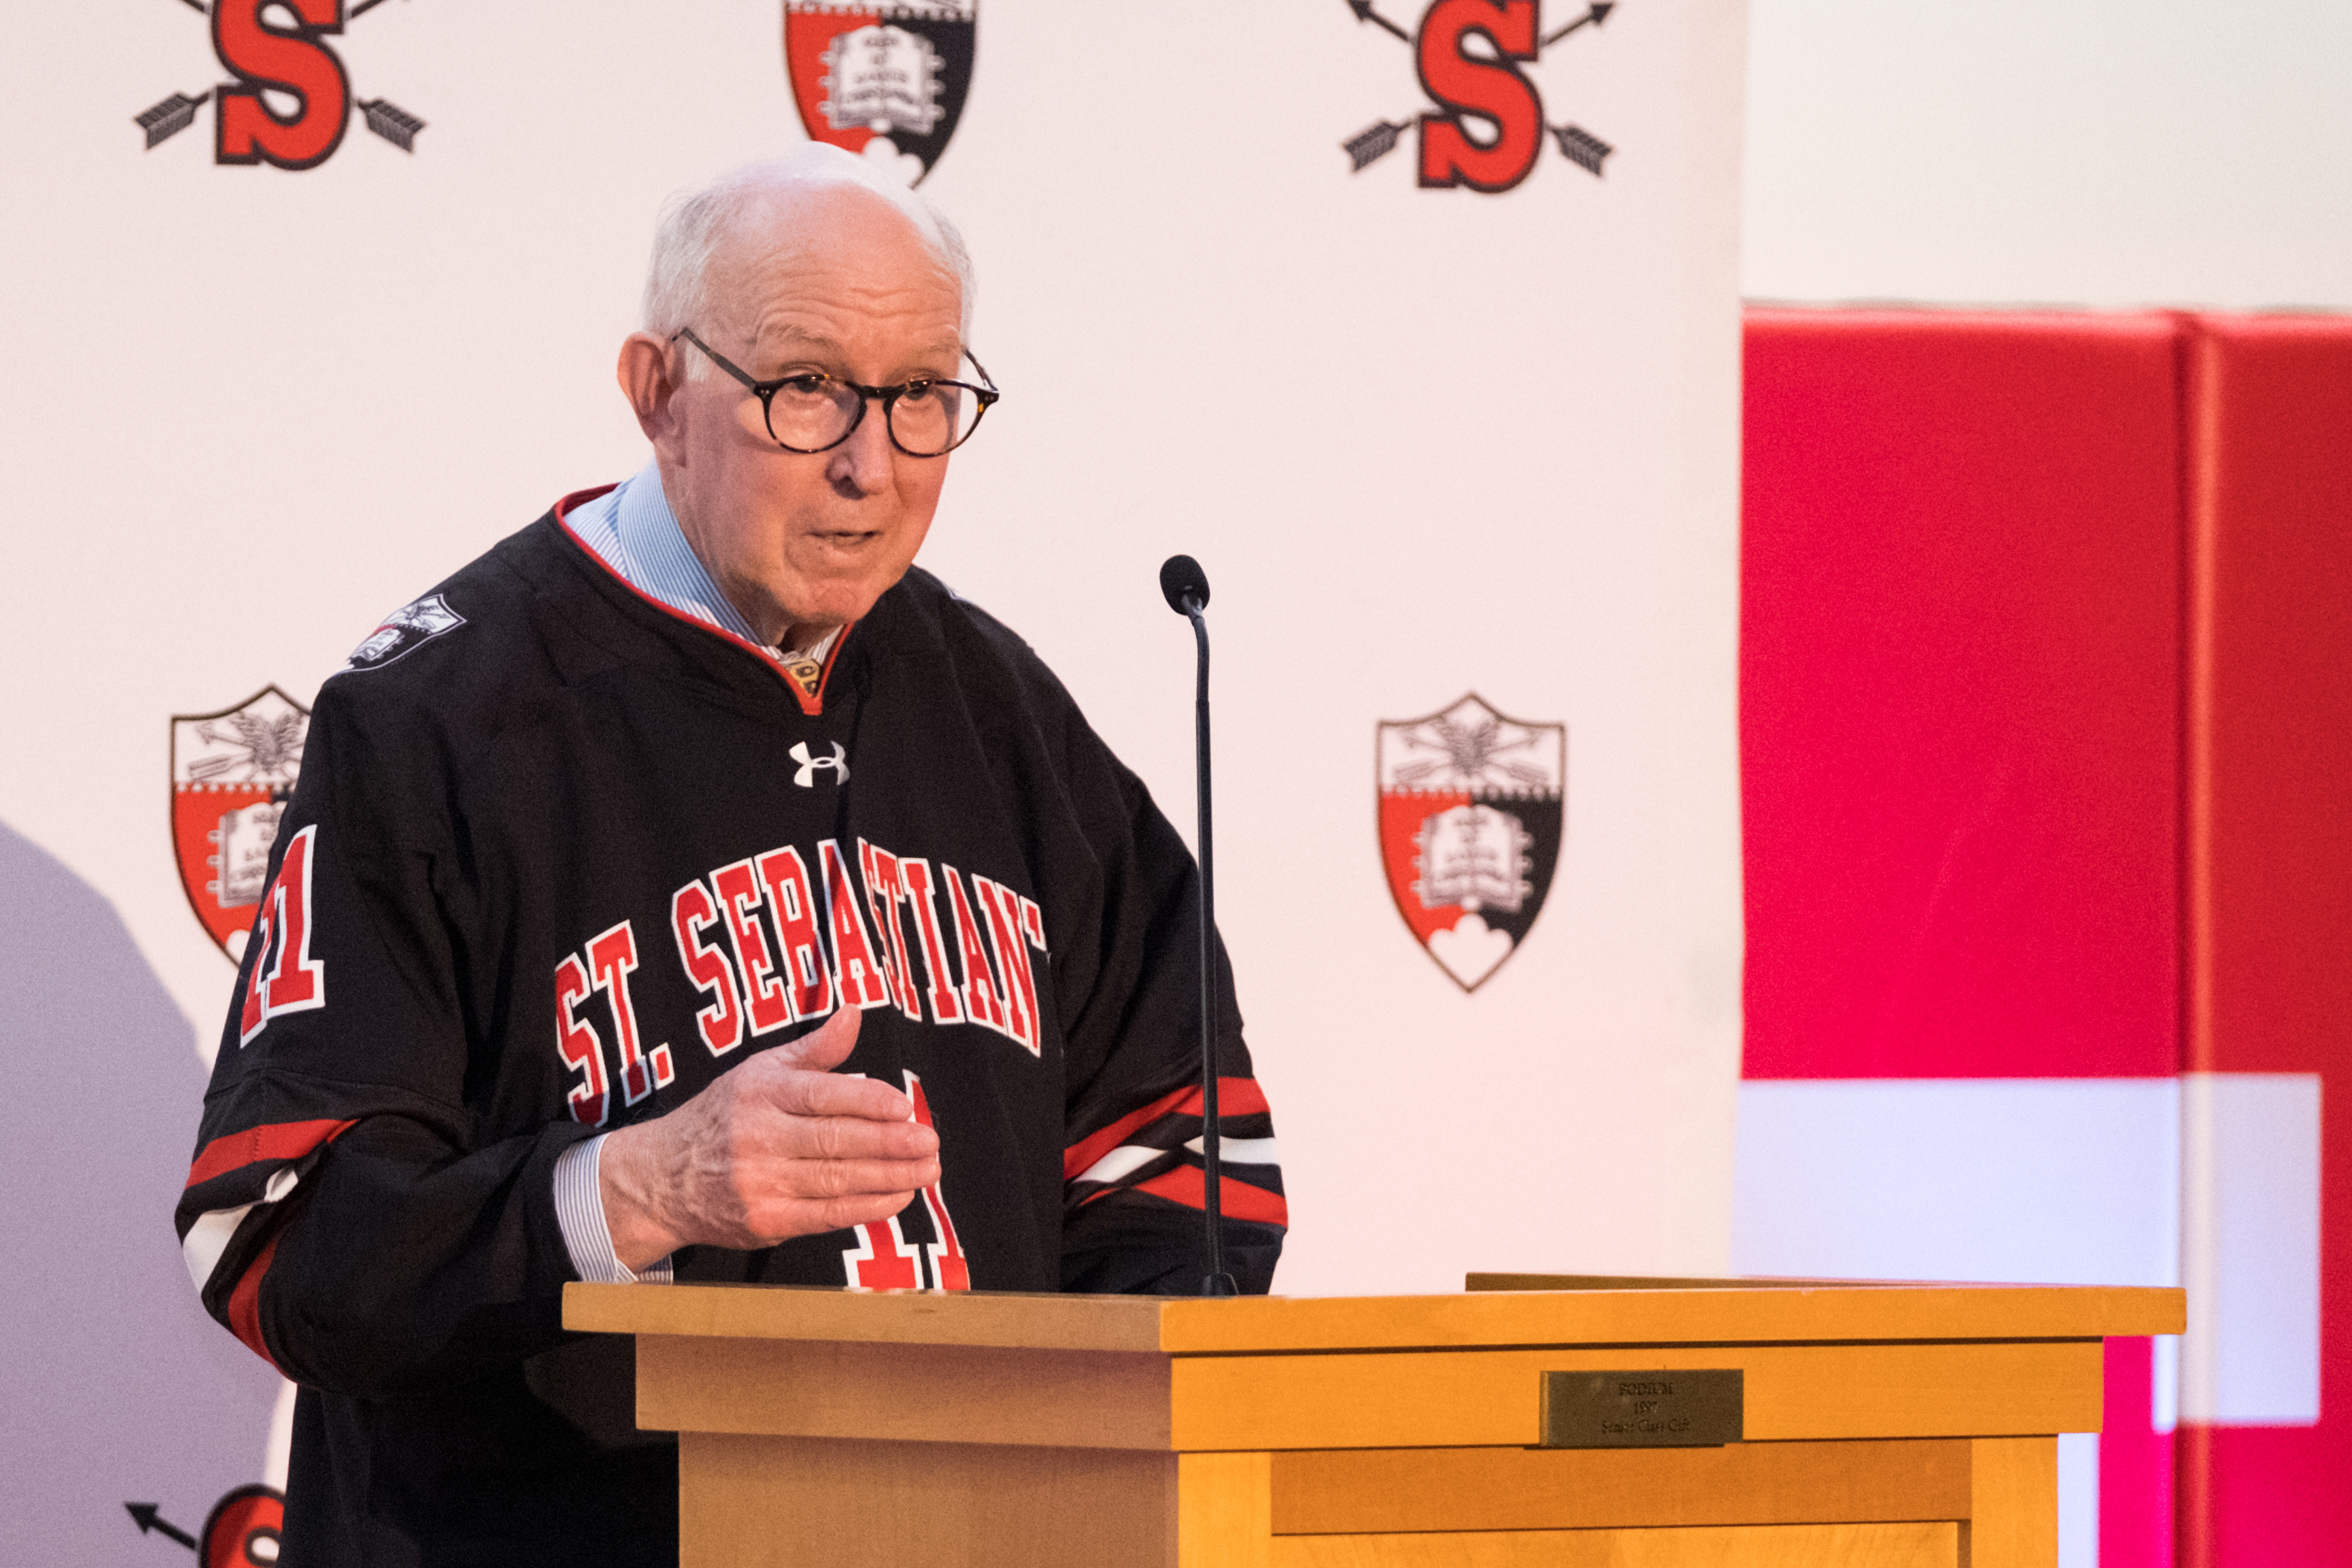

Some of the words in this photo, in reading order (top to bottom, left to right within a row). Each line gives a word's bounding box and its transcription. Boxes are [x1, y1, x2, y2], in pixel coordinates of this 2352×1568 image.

[211, 0, 352, 171] S
[1415, 0, 1546, 194] S
[555, 919, 675, 1128] ST.
[1602, 1420, 1635, 1434] Senior
[1638, 1418, 1665, 1433] Class
[1668, 1418, 1691, 1432] Gift
[1619, 1382, 1674, 1396] PODIUM
